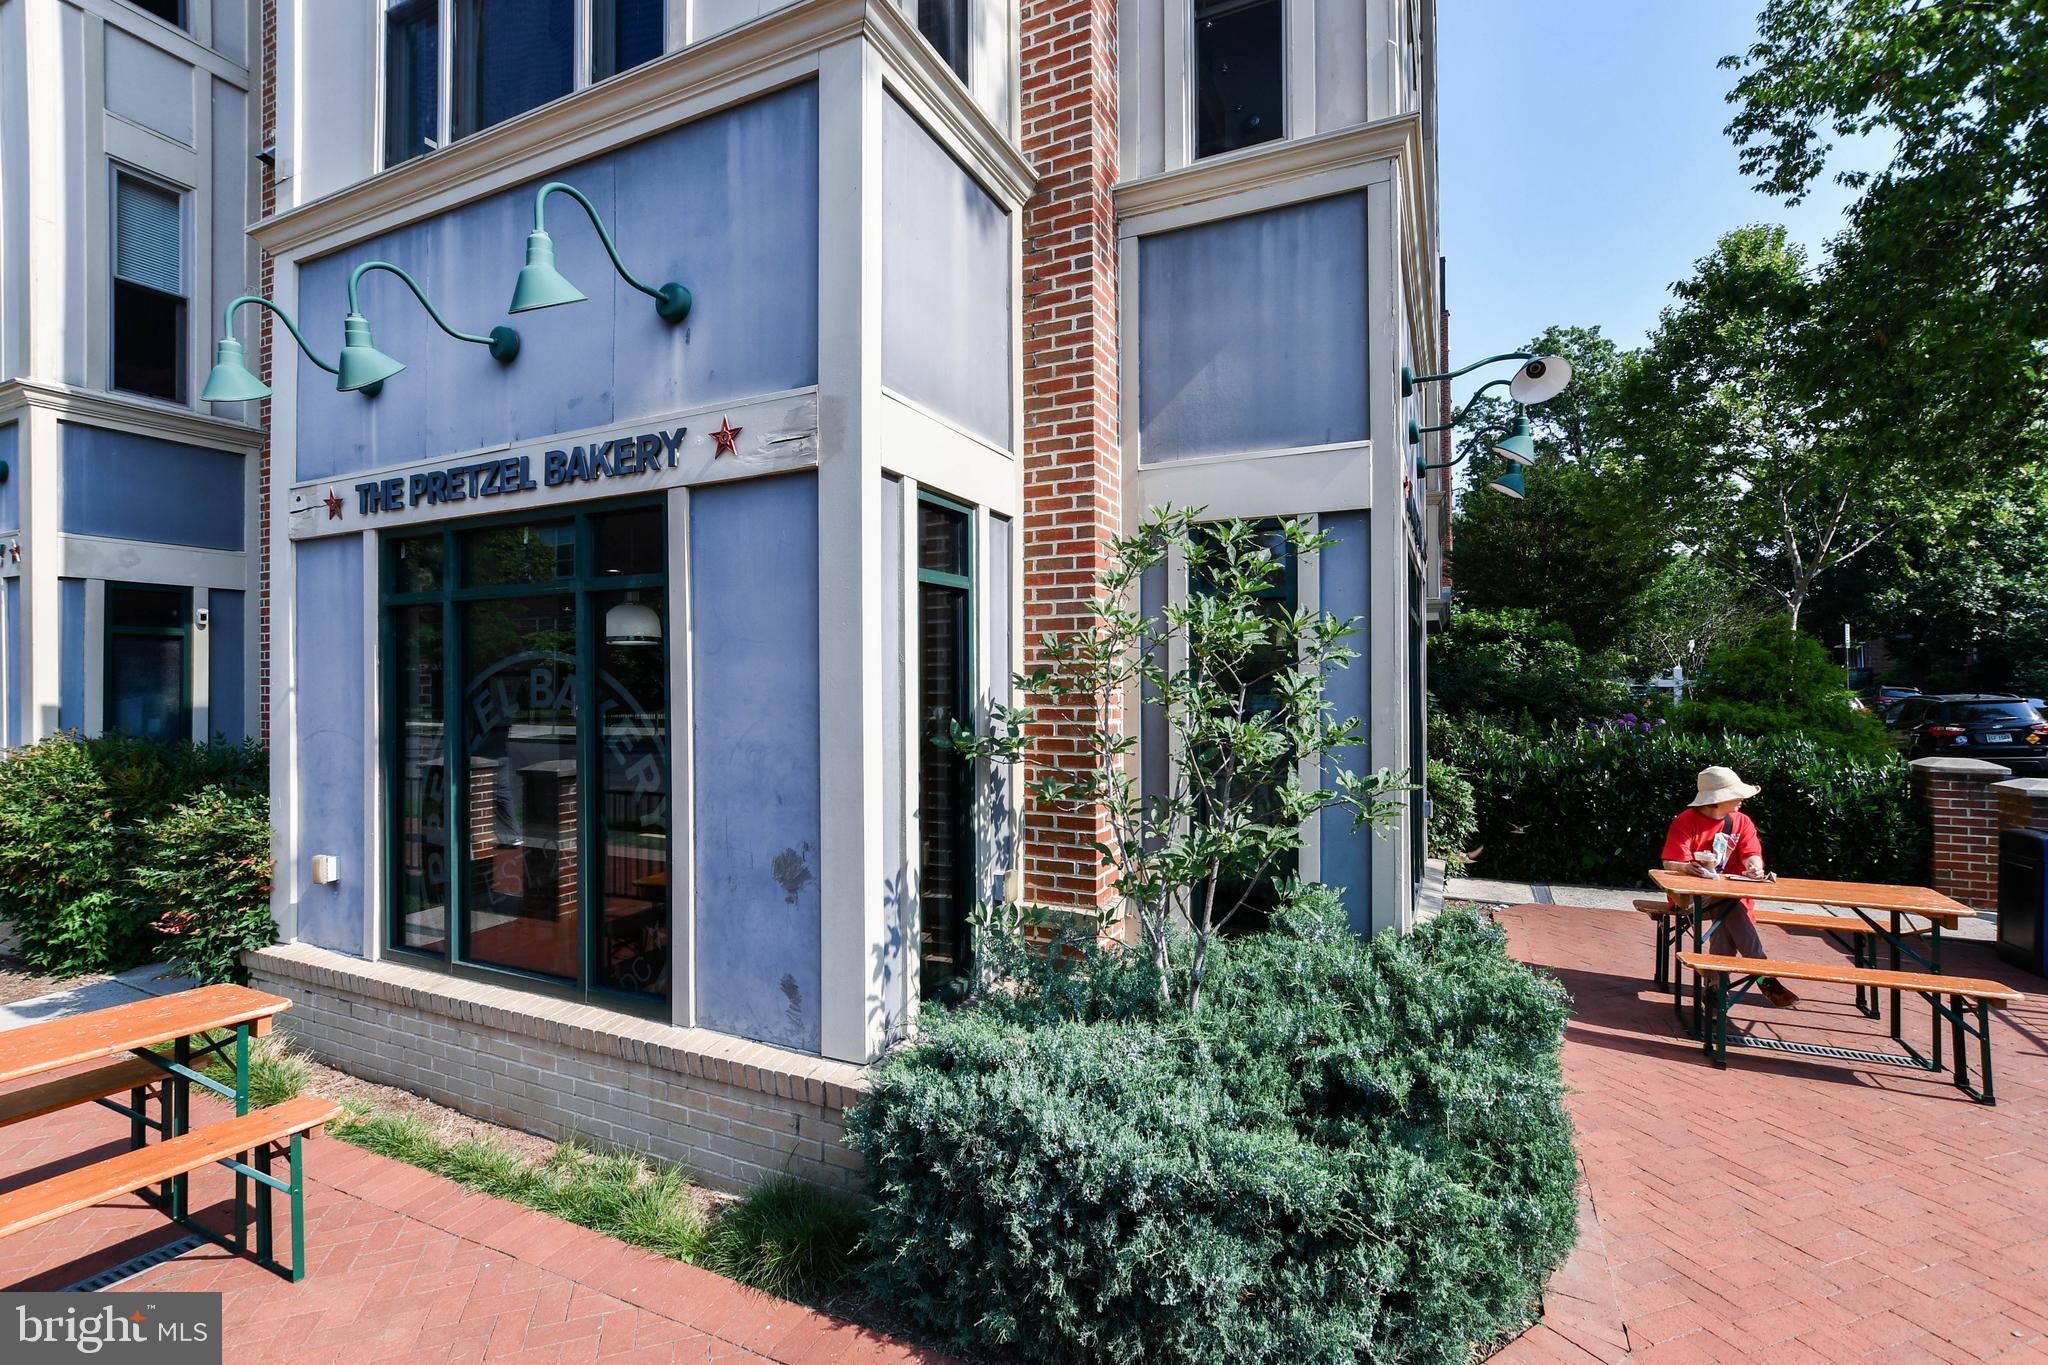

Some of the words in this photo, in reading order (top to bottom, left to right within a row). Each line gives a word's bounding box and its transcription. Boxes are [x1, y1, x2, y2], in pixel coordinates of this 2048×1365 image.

[355, 476, 404, 514] THE
[408, 455, 537, 507] PRETZEL
[544, 427, 687, 487] BAKERY
